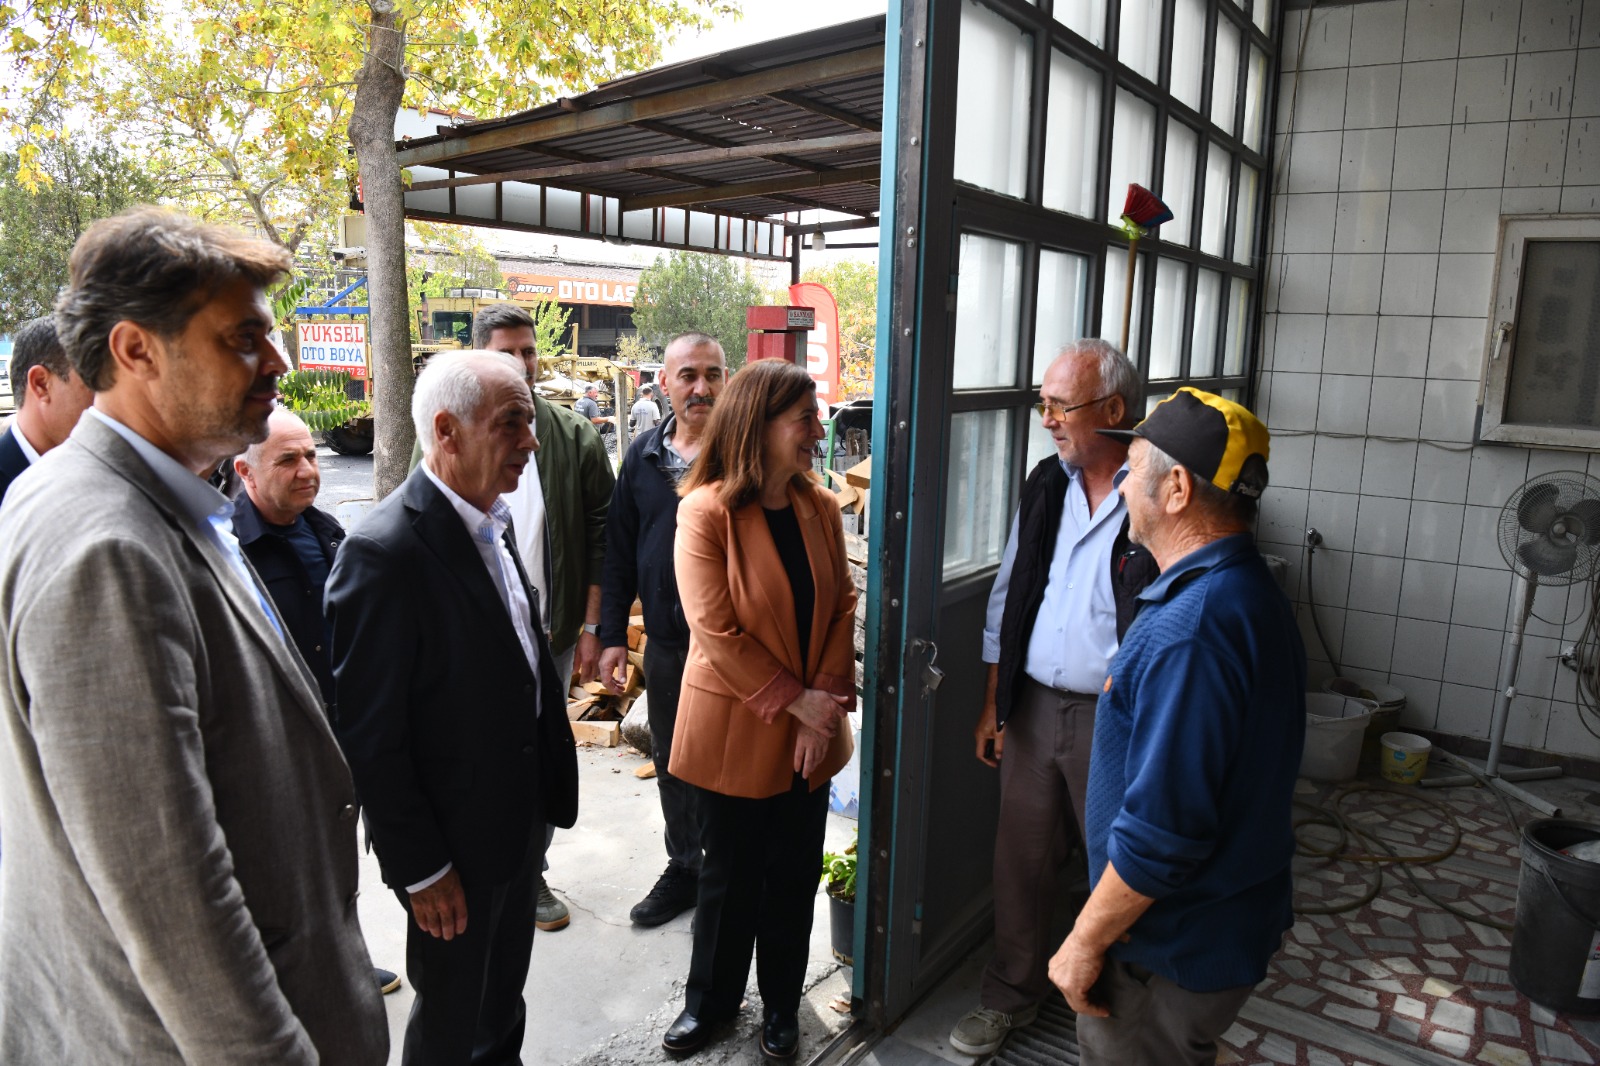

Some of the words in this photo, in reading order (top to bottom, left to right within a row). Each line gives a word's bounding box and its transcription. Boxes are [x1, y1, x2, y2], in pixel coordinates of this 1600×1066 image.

[558, 280, 599, 301] OTO
[300, 322, 363, 343] YÜKSEL
[301, 346, 325, 361] OTO
[330, 347, 364, 363] BOYA
[356, 367, 365, 376] 22
